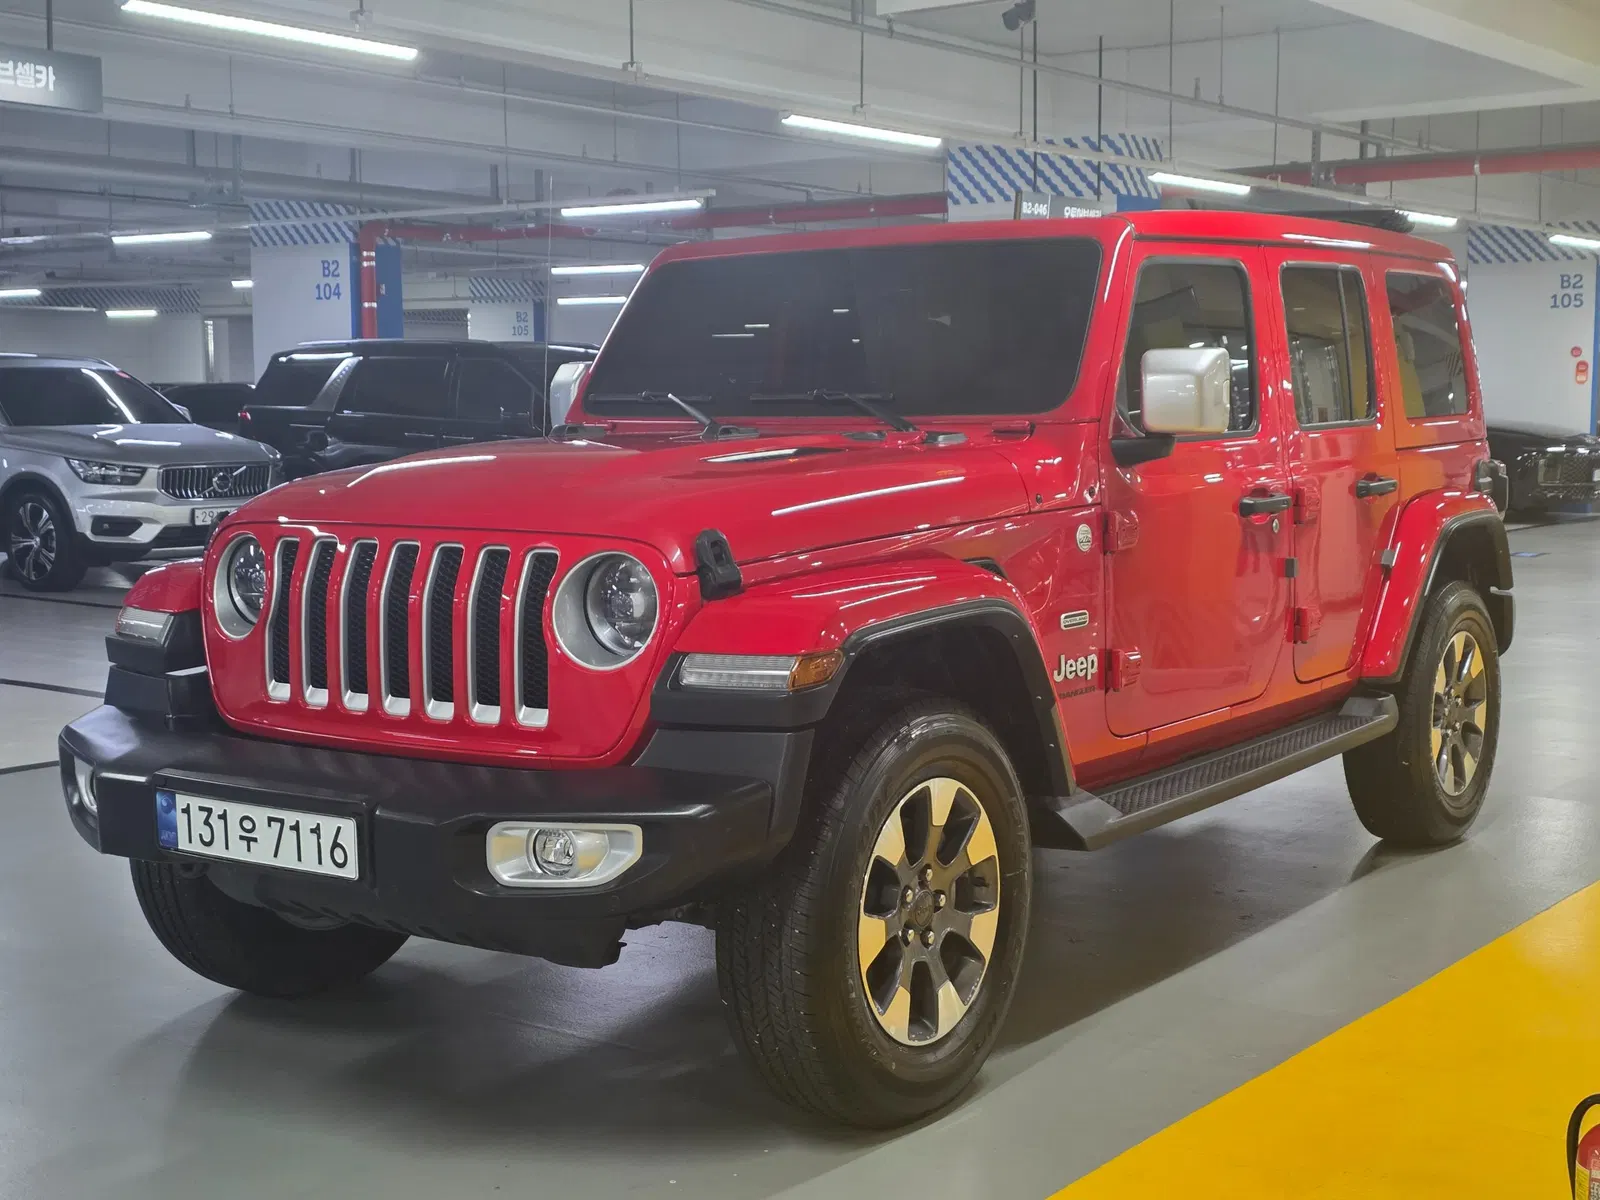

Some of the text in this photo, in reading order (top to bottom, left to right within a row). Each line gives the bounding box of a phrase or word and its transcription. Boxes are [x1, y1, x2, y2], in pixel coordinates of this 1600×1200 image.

[1022, 201, 1048, 216] B2-046
[320, 259, 340, 278] B2
[1559, 273, 1584, 289] B2
[315, 282, 342, 301] 104
[1550, 293, 1584, 308] 105
[515, 311, 529, 323] B2
[511, 325, 529, 336] 105
[1053, 653, 1098, 683] Jeep
[180, 802, 349, 869] 131우7116
